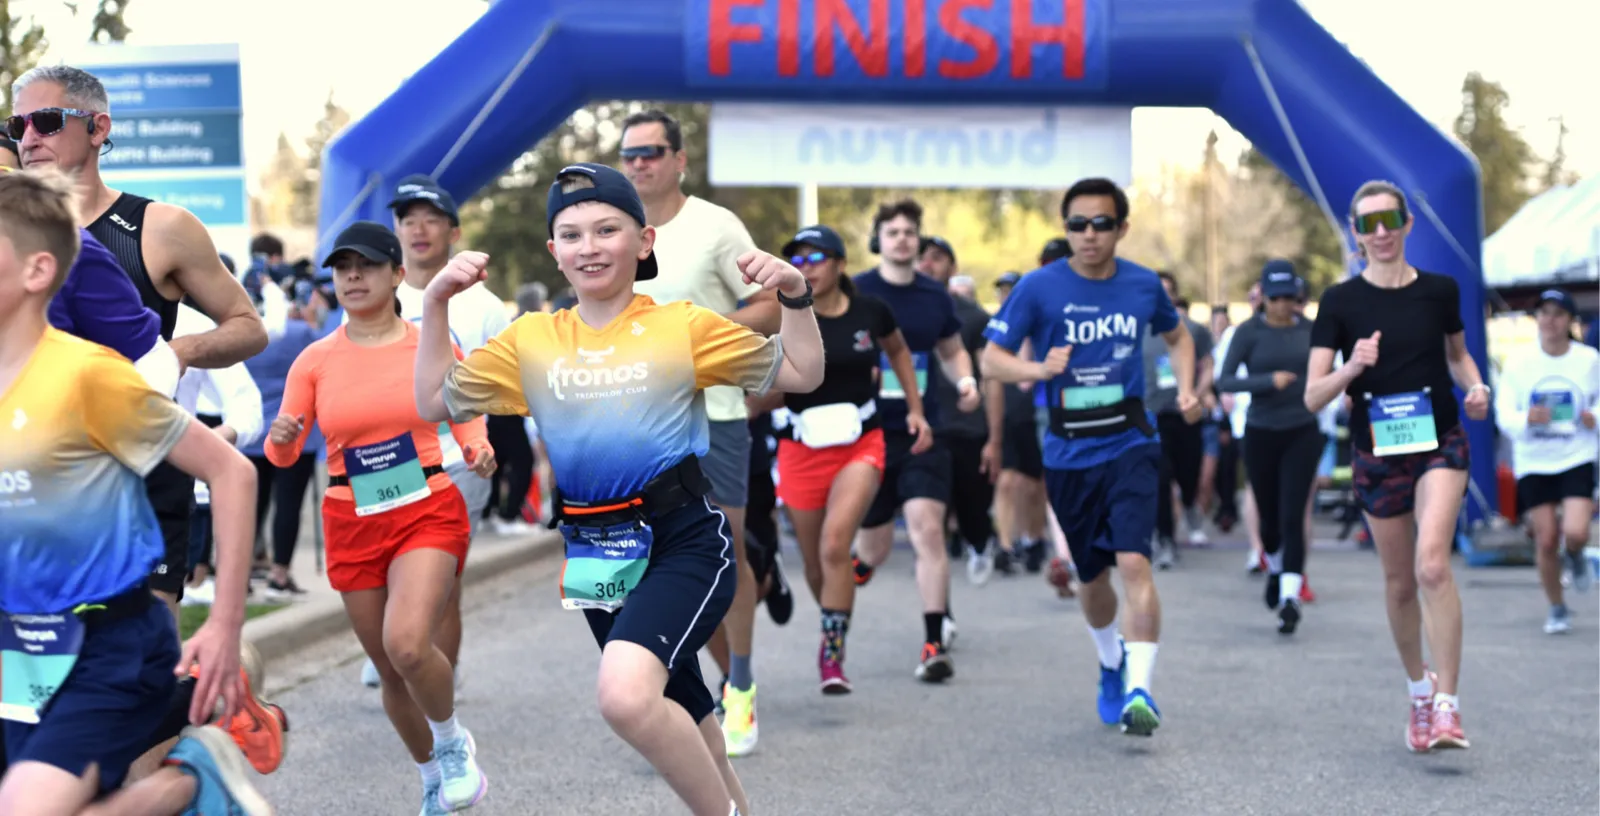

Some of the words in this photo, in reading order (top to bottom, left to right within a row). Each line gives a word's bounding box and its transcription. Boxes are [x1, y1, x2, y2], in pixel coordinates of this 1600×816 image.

[708, 0, 1085, 79] FINISH
[138, 120, 202, 138] Building
[149, 146, 213, 163] Building
[1064, 312, 1137, 344] 10KM
[546, 357, 649, 400] Kronos
[574, 389, 622, 400] TRIATHLON
[625, 386, 648, 395] CLUB
[361, 452, 397, 467] bumrun
[377, 484, 401, 501] 361
[595, 579, 626, 598] 304
